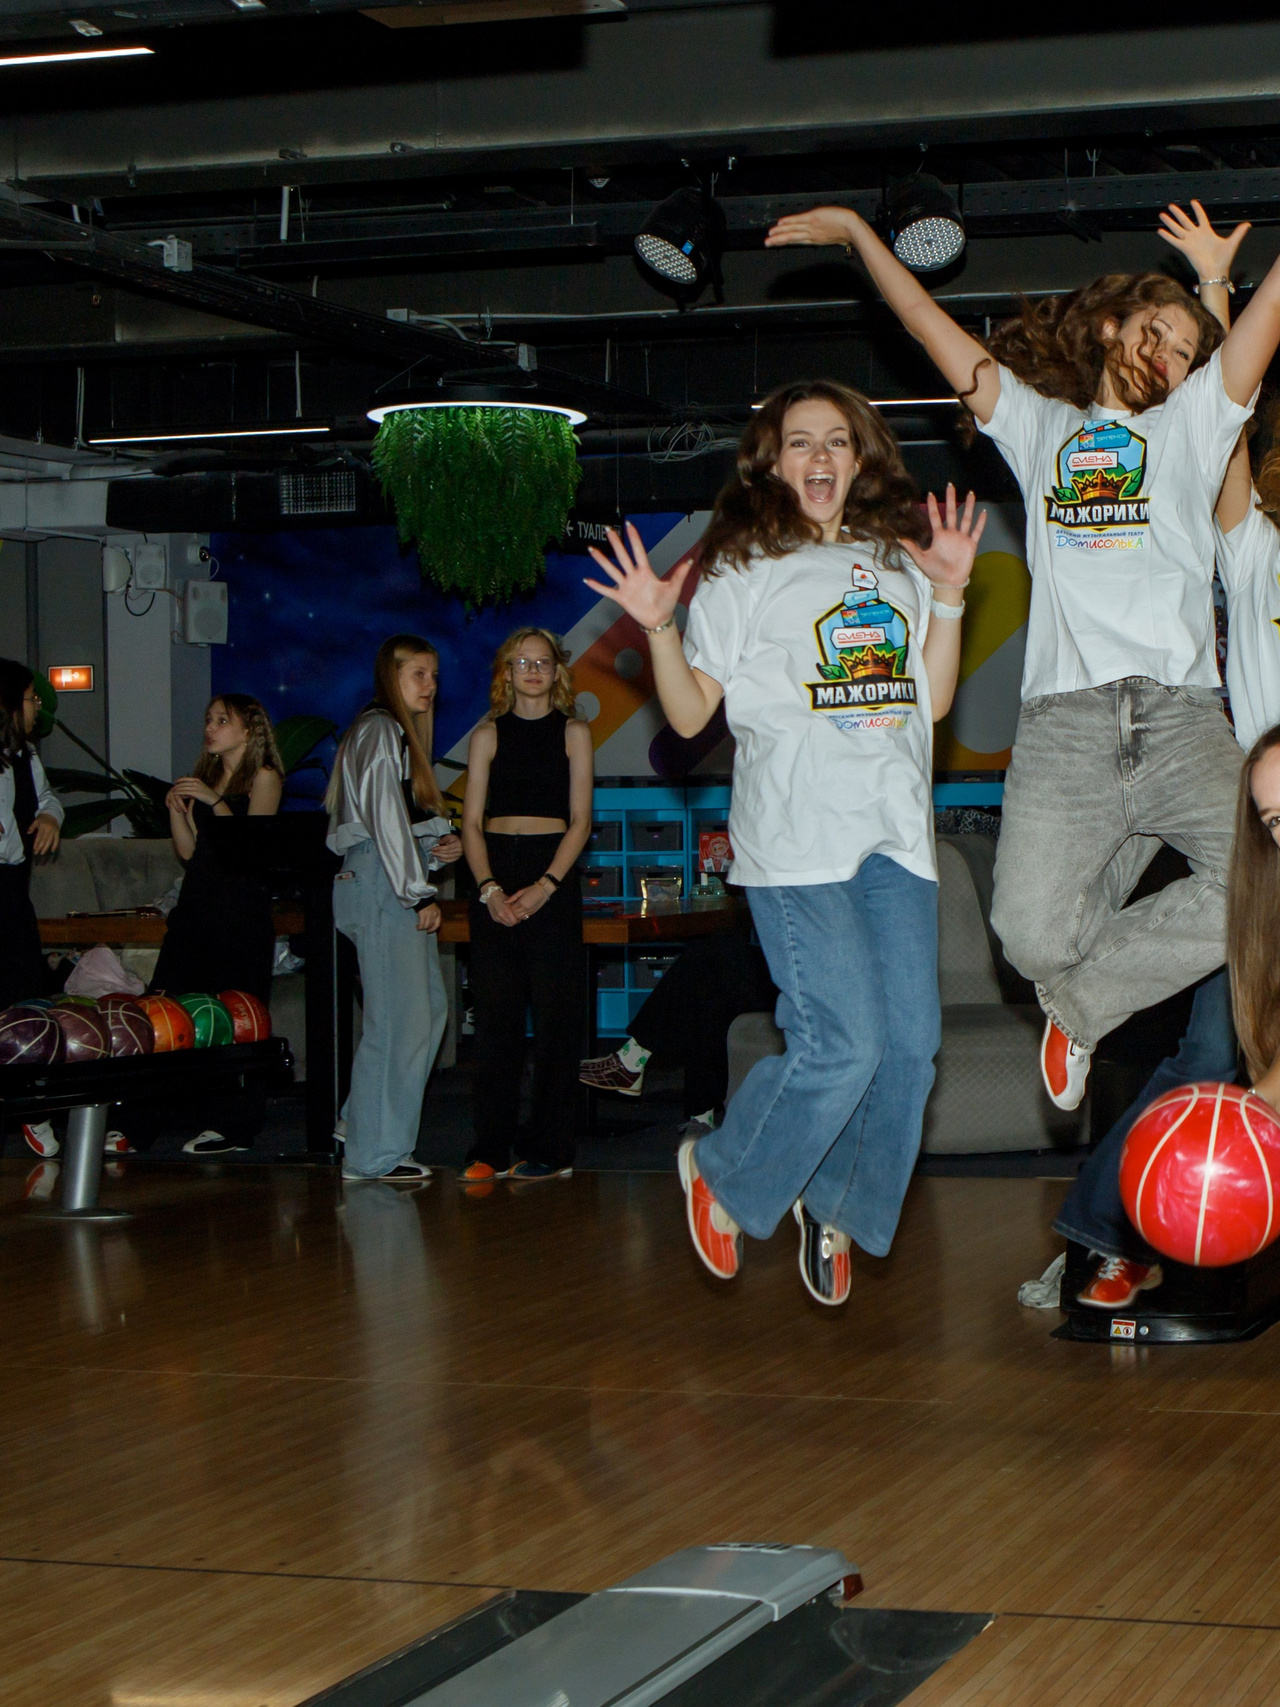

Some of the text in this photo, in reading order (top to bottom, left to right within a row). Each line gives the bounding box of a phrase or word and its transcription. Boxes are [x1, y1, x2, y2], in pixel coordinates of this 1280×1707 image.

[1050, 502, 1149, 524] МАЖОРИКИ
[577, 521, 613, 542] ТУАЛЕ
[816, 682, 914, 705] МАЖОРИКИ
